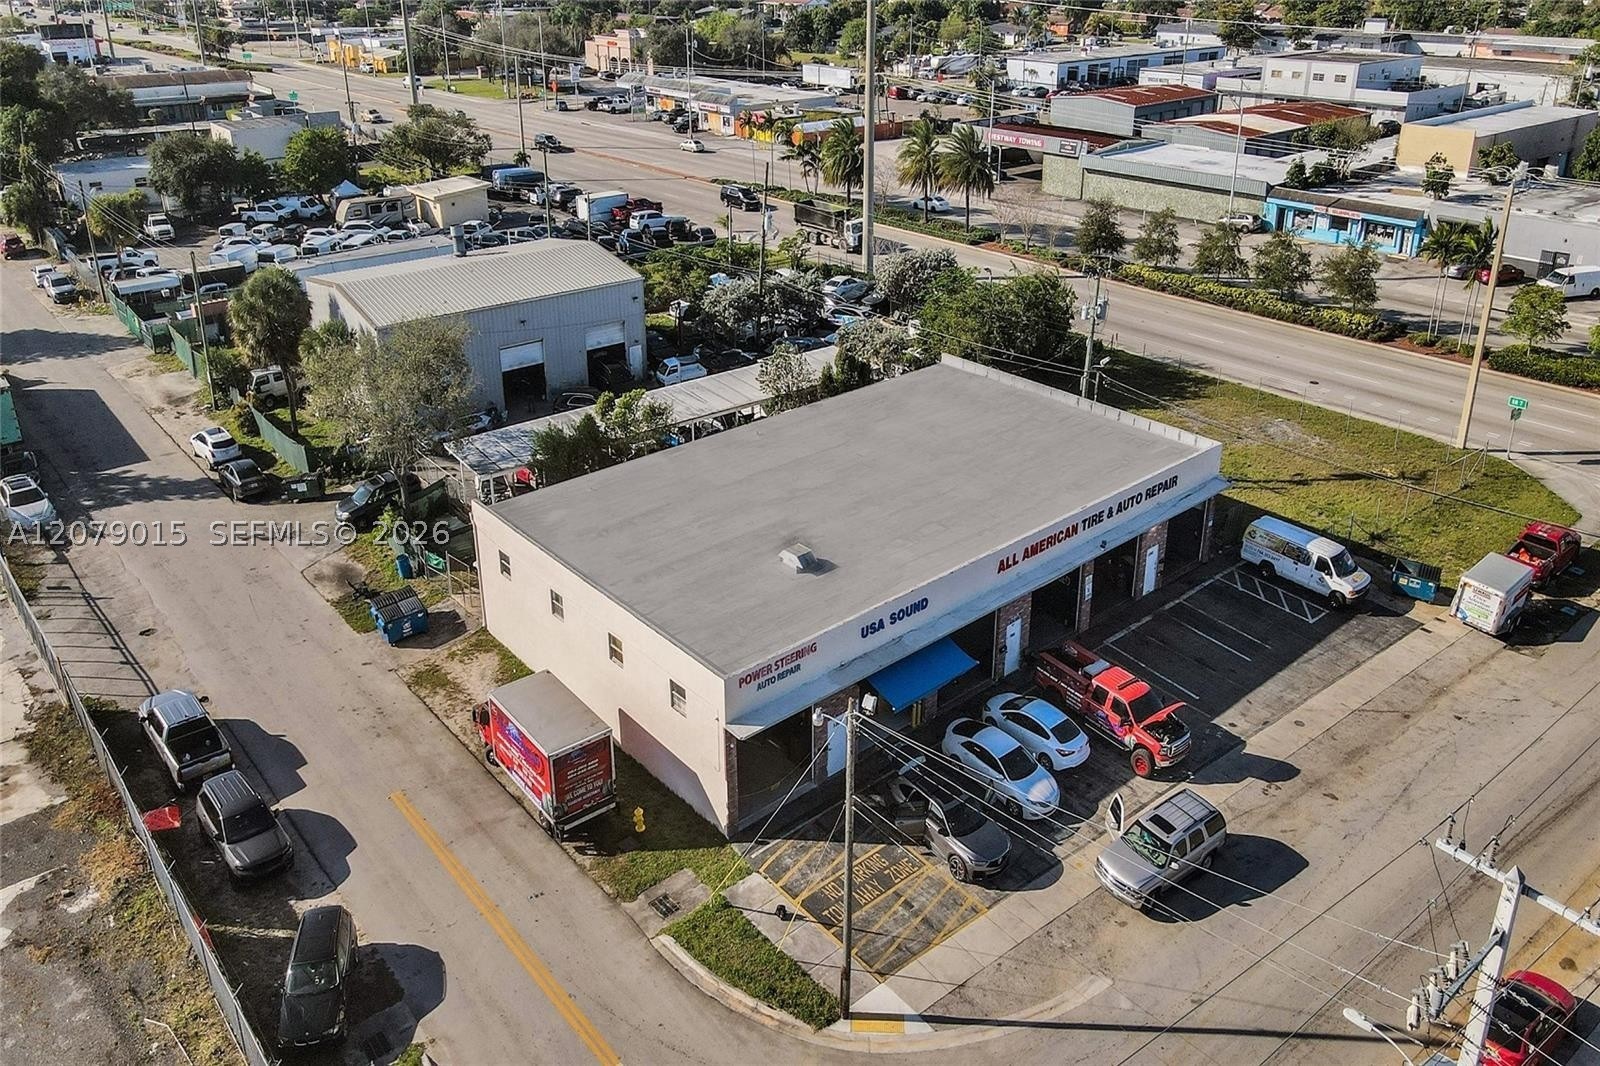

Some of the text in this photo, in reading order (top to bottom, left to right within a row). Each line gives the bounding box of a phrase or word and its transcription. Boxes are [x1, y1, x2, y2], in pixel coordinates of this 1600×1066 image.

[989, 133, 1042, 147] ESTWAY TOWING
[997, 475, 1178, 574] ALL AMERICAN TIRE & AUTO REPAIR
[861, 597, 929, 638] USA SOUND
[738, 642, 817, 688] POWER STEERING
[756, 664, 802, 691] AUTO REPAIR
[821, 853, 889, 900] NO ARKING
[852, 878, 885, 906] AWAY
[883, 858, 919, 883] ZONE
